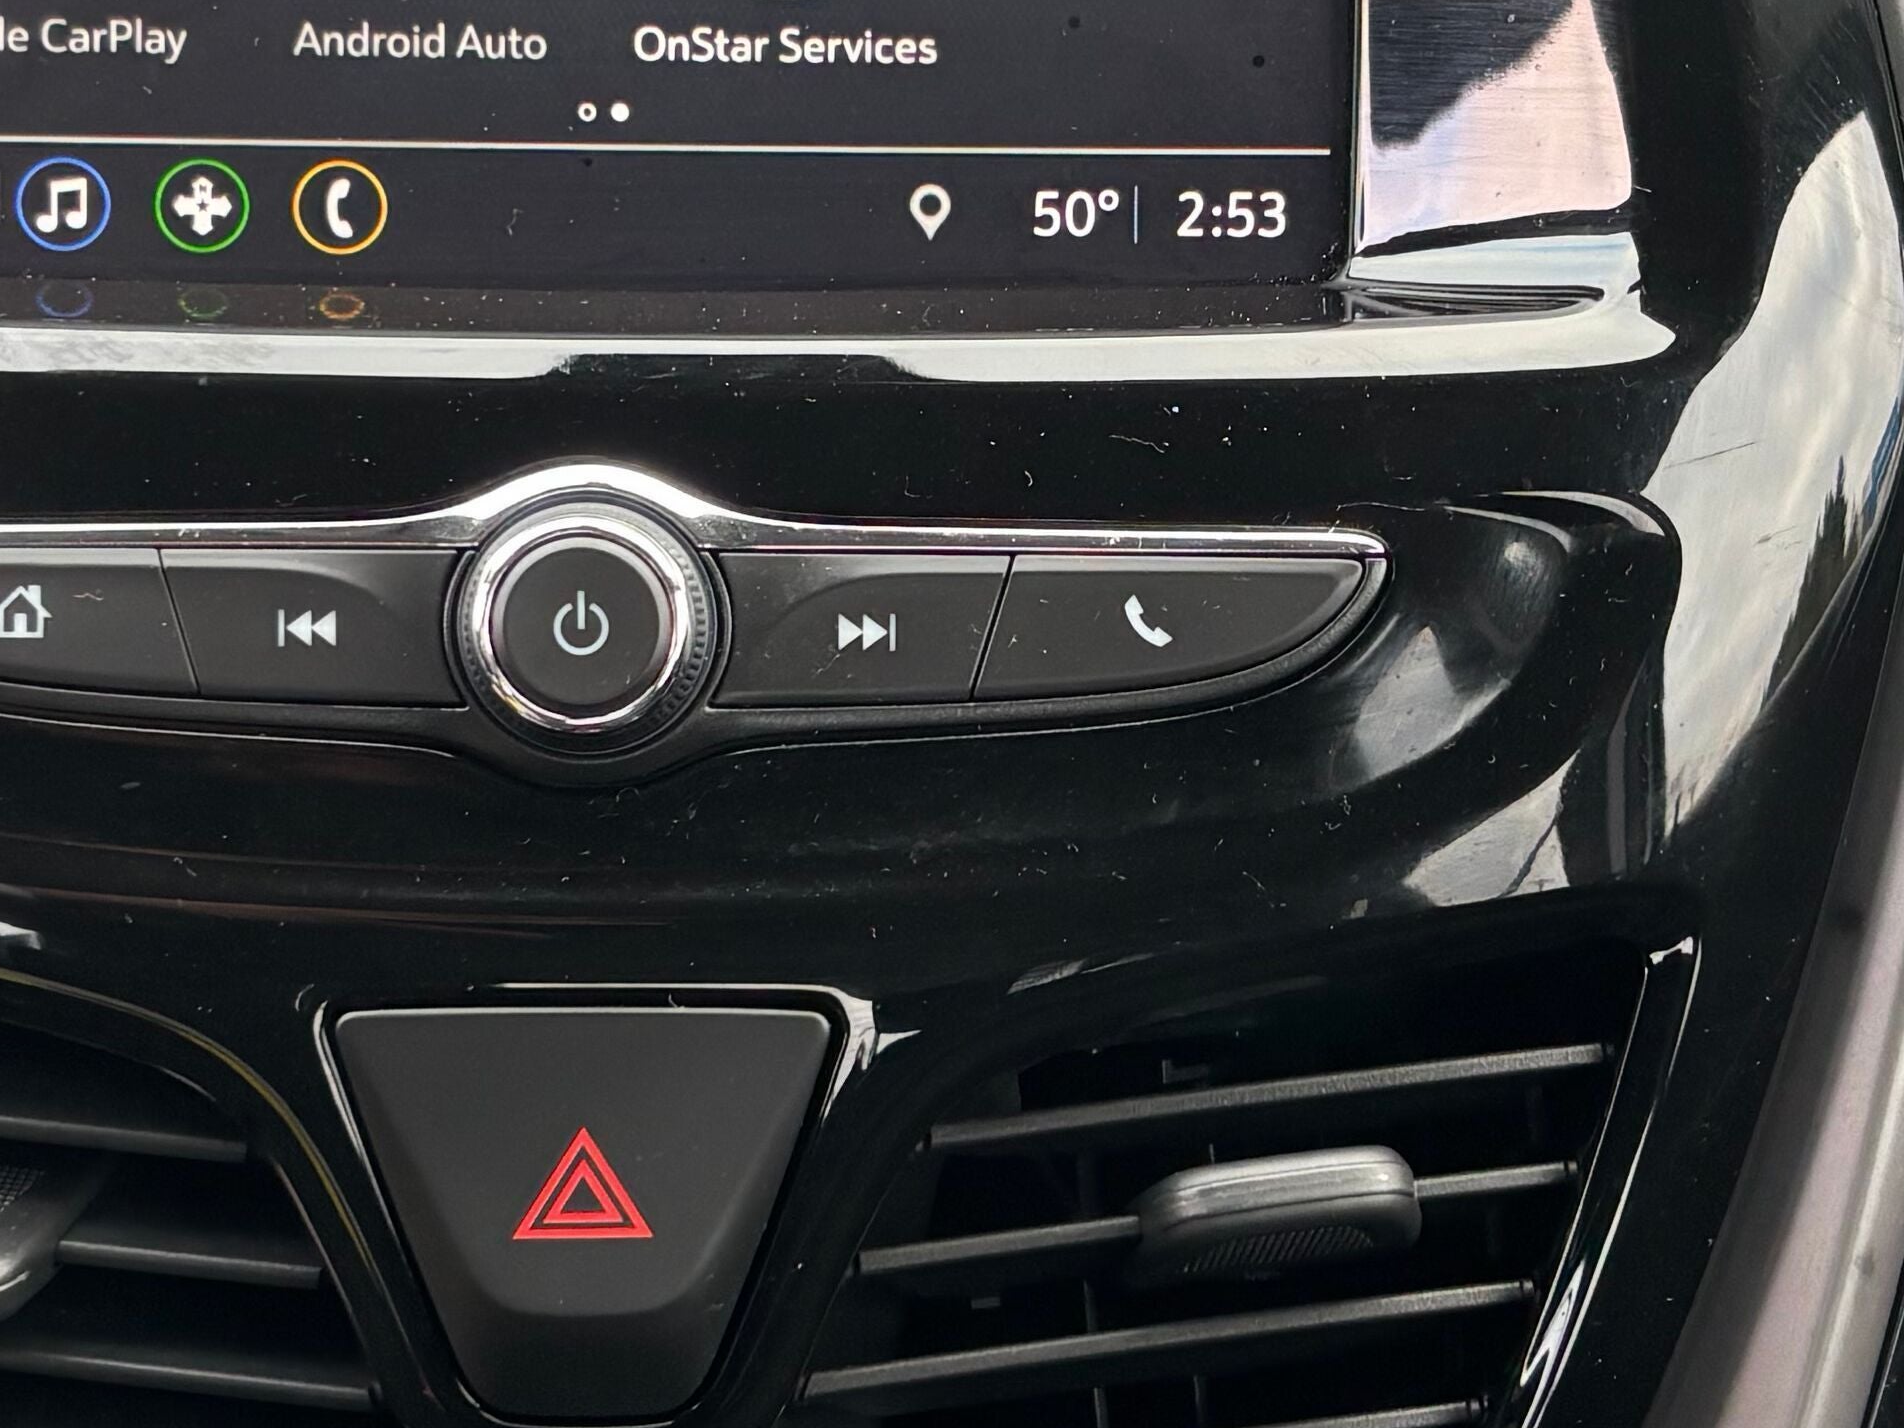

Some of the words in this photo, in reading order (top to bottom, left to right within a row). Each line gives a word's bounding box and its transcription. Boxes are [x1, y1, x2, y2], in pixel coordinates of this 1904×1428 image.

[40, 17, 188, 65] CarPlay
[293, 21, 446, 59] Android
[455, 24, 548, 60] Auto
[633, 25, 770, 63] OnStar
[778, 27, 938, 65] Services
[1176, 190, 1286, 238] 2:53
